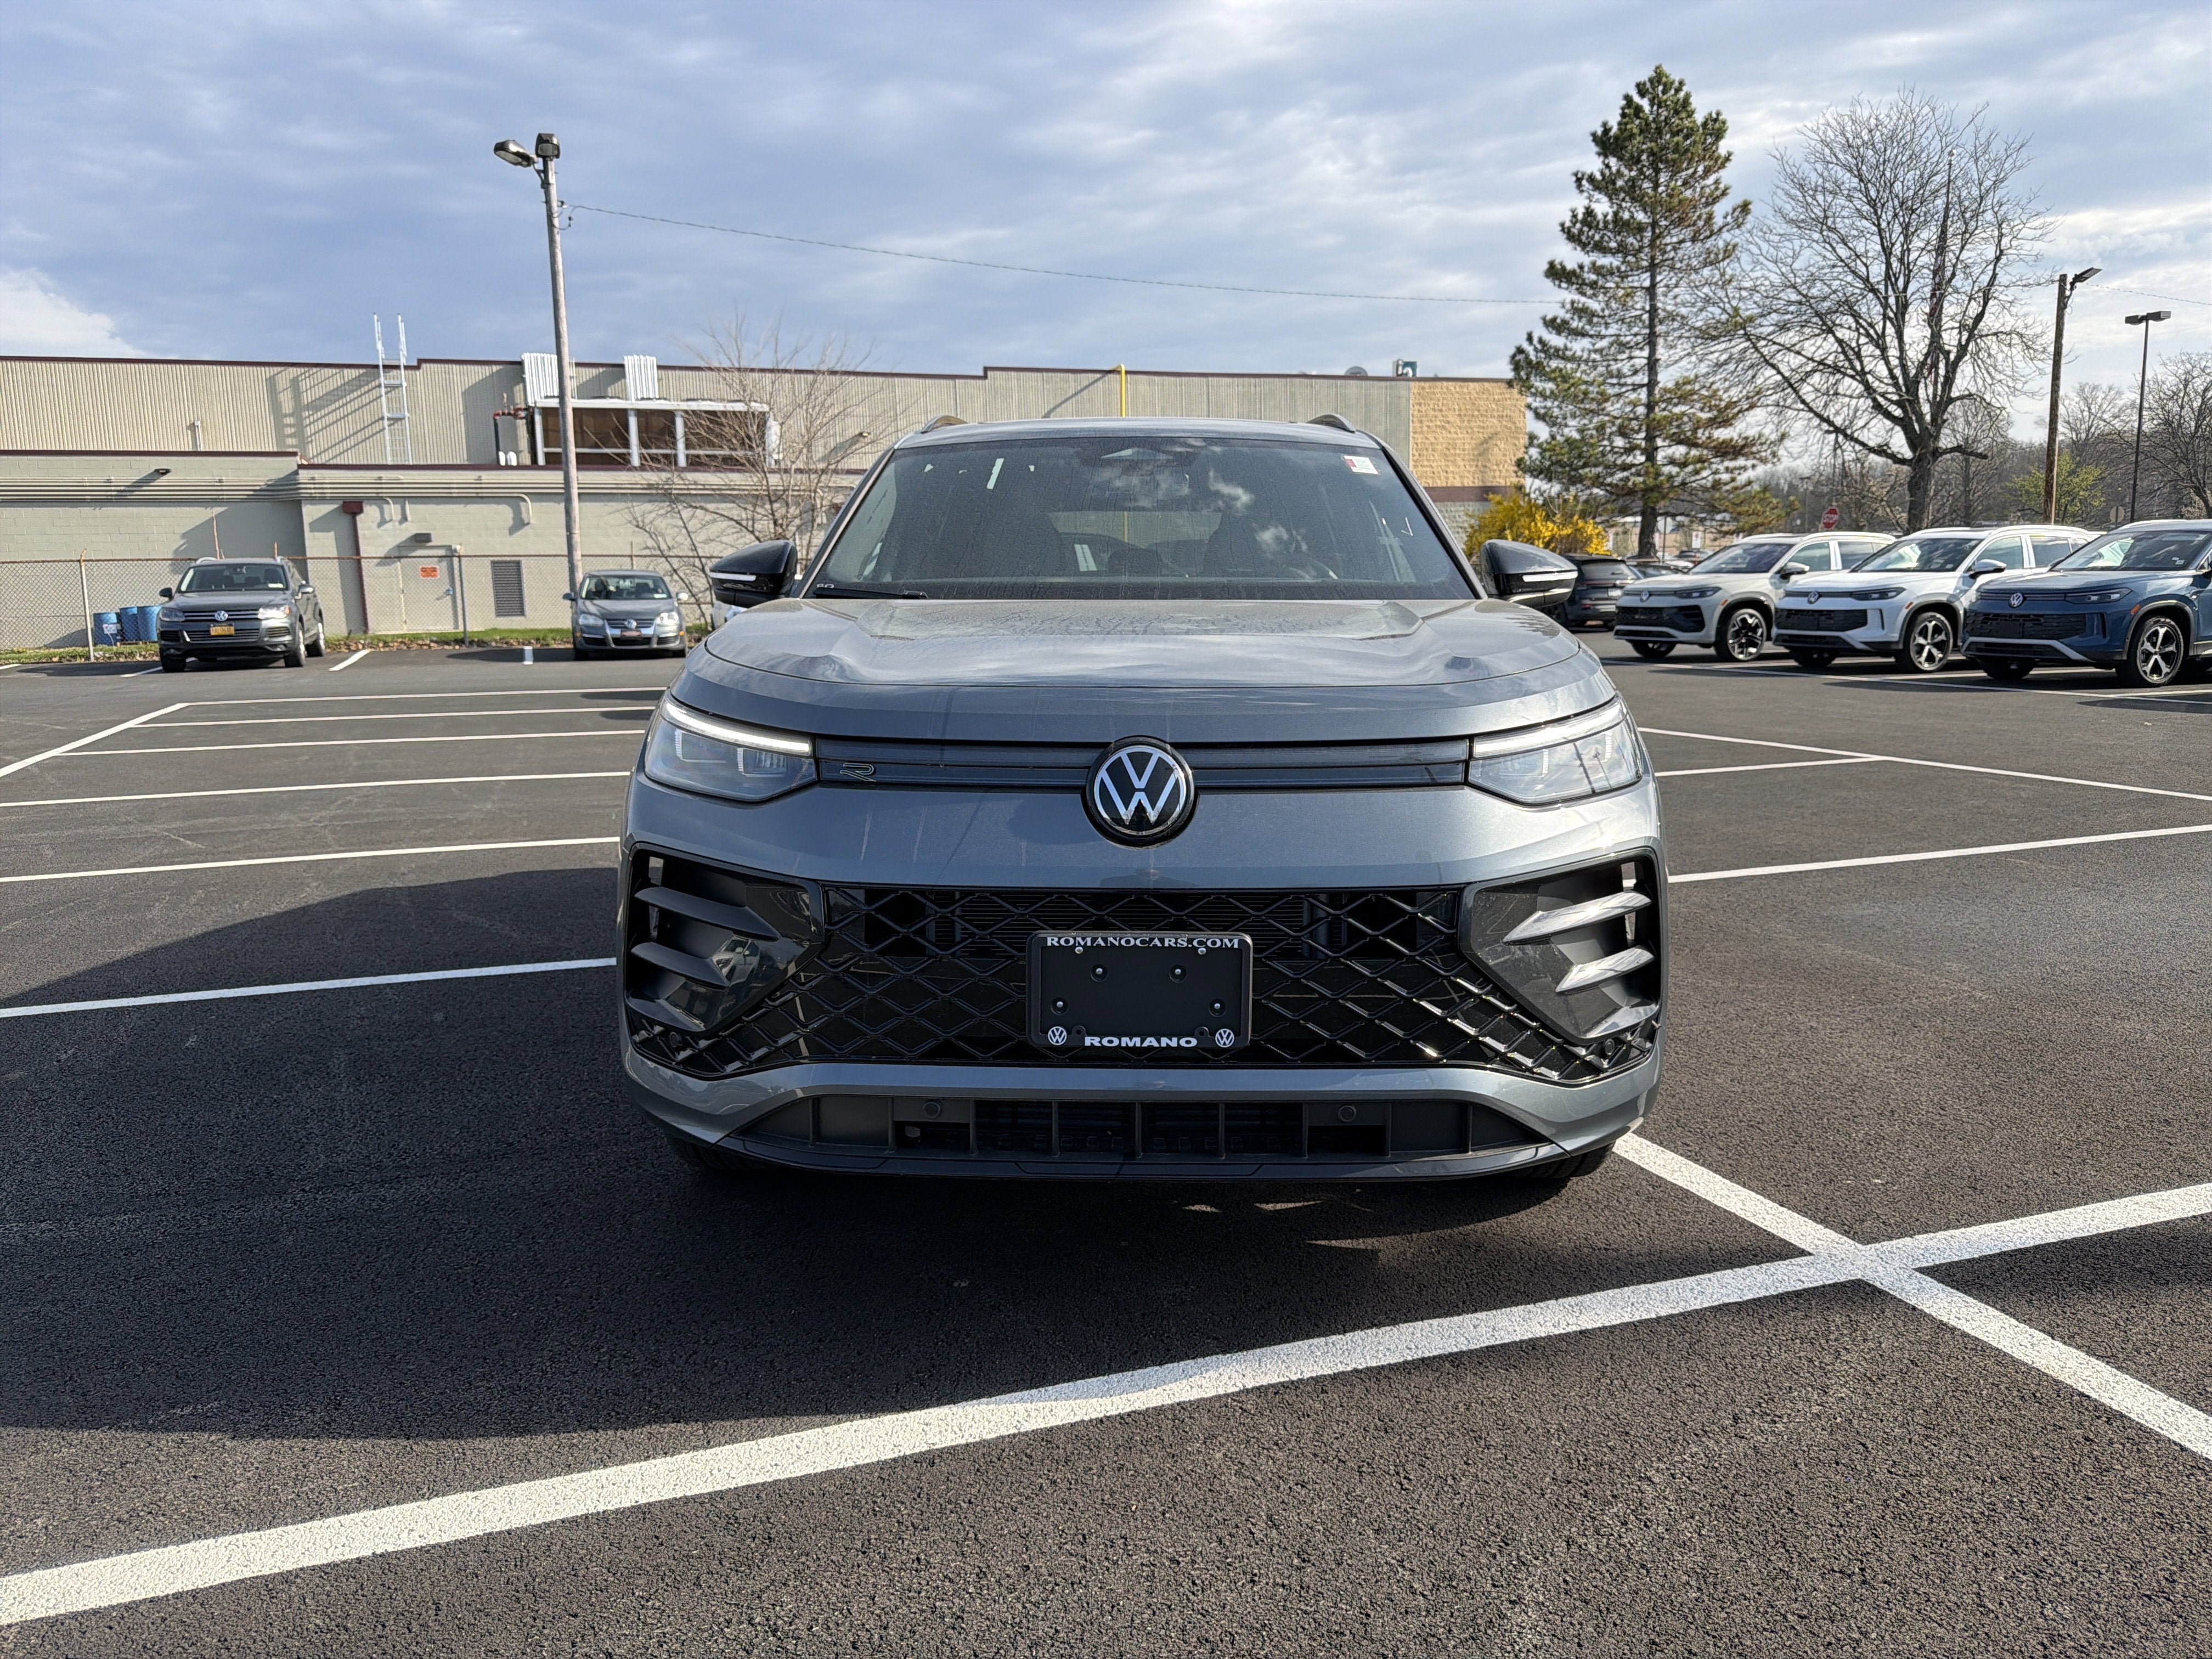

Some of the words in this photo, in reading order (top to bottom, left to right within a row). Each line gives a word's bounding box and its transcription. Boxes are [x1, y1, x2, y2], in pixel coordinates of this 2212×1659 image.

[1095, 745, 1186, 836] VW
[1047, 936, 1239, 949] ROMANOCARS.COM
[1048, 1026, 1067, 1046] VW
[1085, 1036, 1197, 1047] ROMANO
[1215, 1028, 1234, 1048] VW
